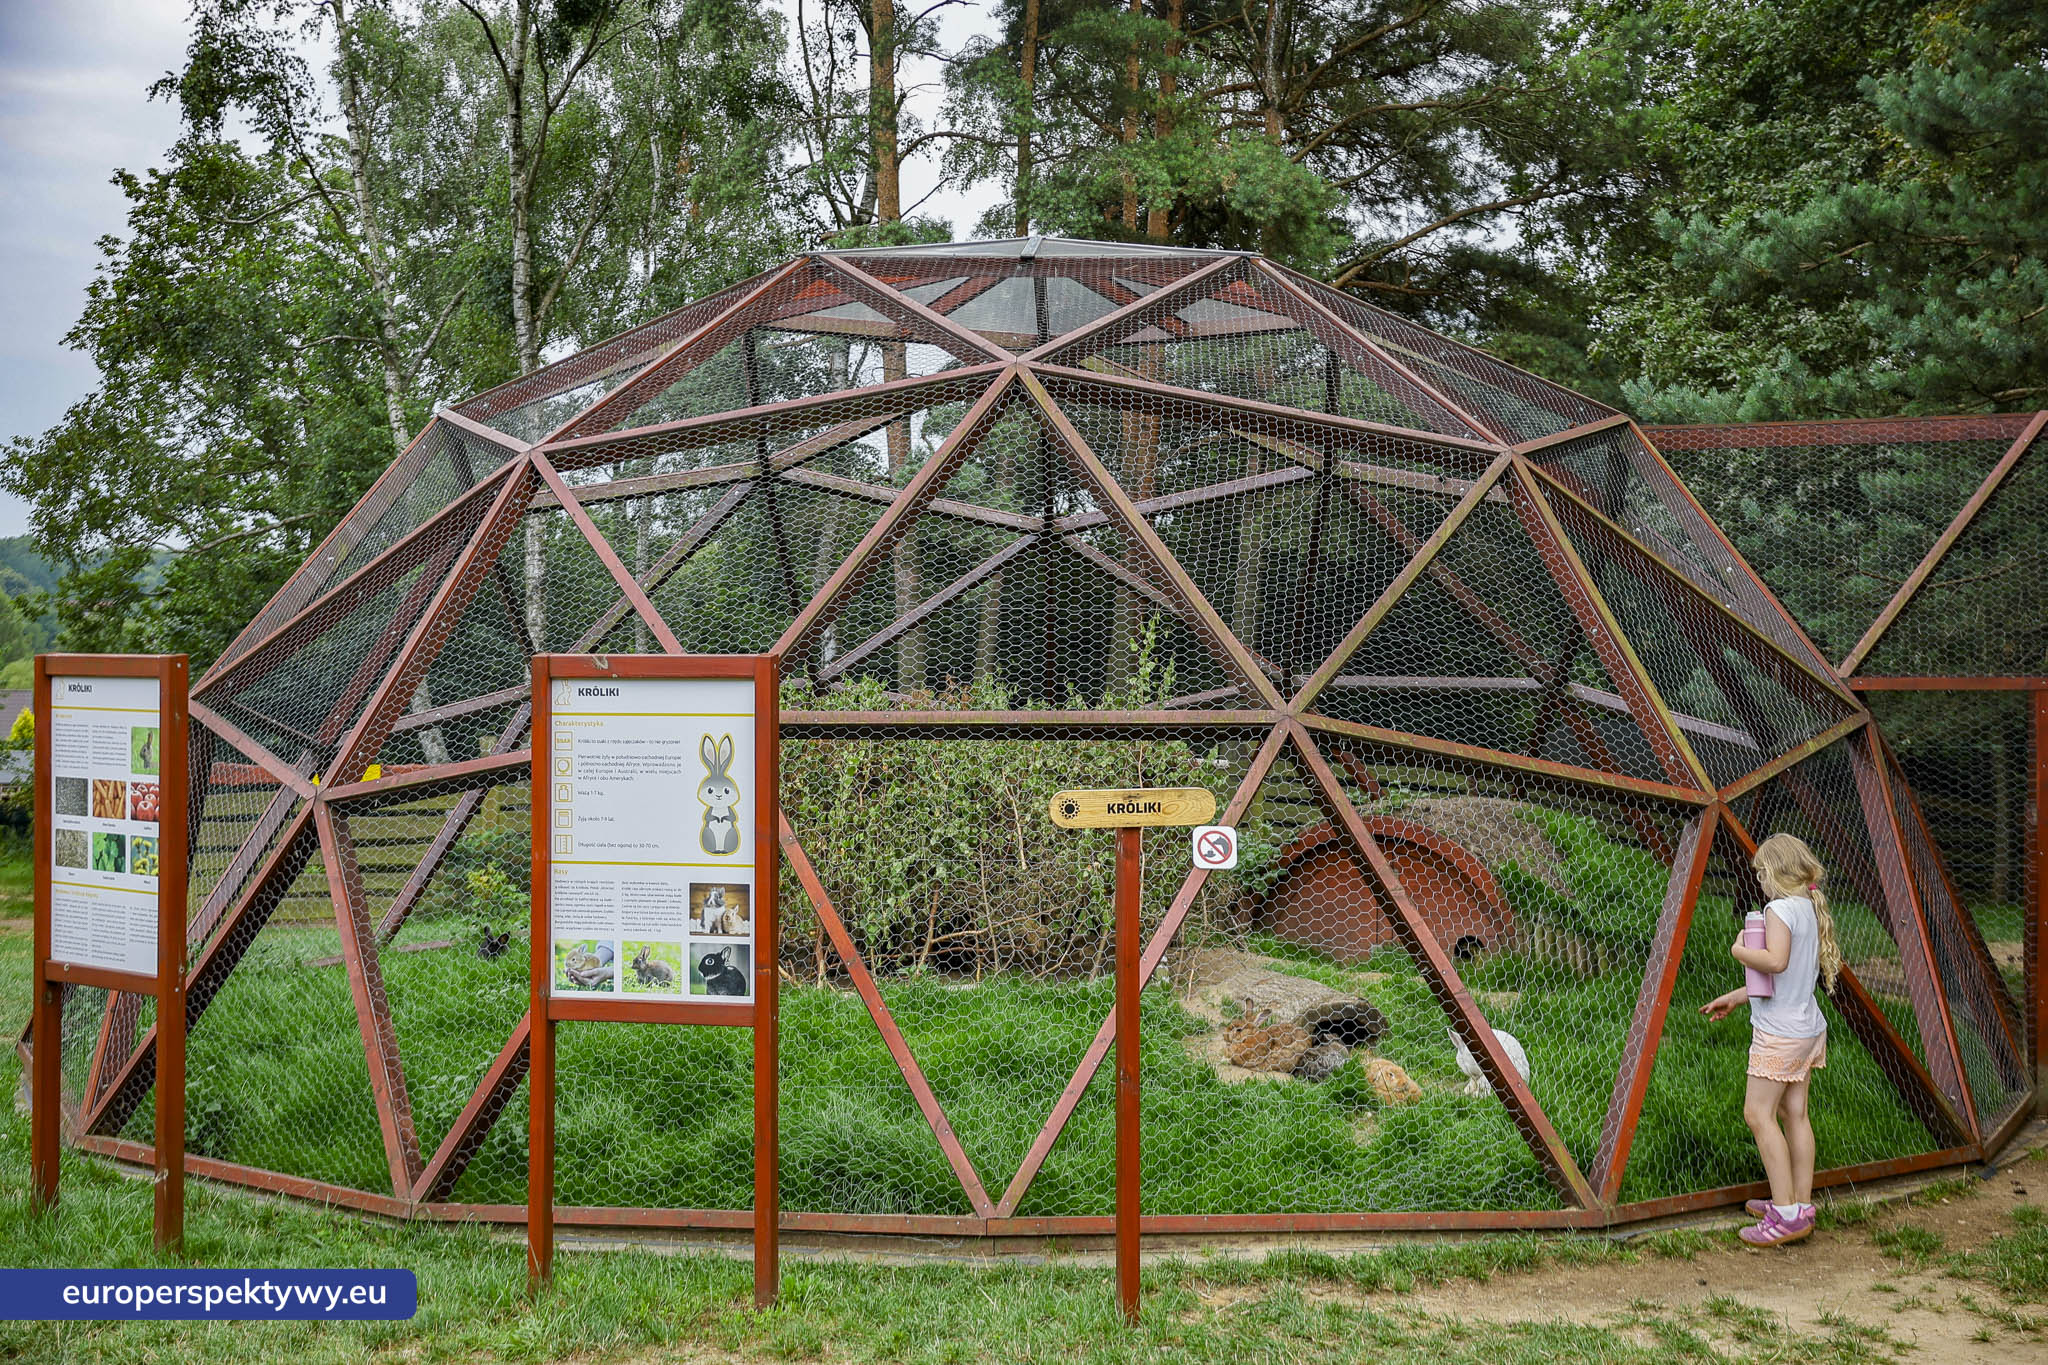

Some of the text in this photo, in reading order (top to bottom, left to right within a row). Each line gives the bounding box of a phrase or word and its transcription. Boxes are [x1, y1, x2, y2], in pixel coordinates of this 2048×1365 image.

[68, 682, 92, 693] KRÓLIKI
[578, 685, 620, 697] KRÓLIKI
[554, 720, 604, 728] Charakterystyka
[1106, 799, 1162, 814] KRÓLIKI
